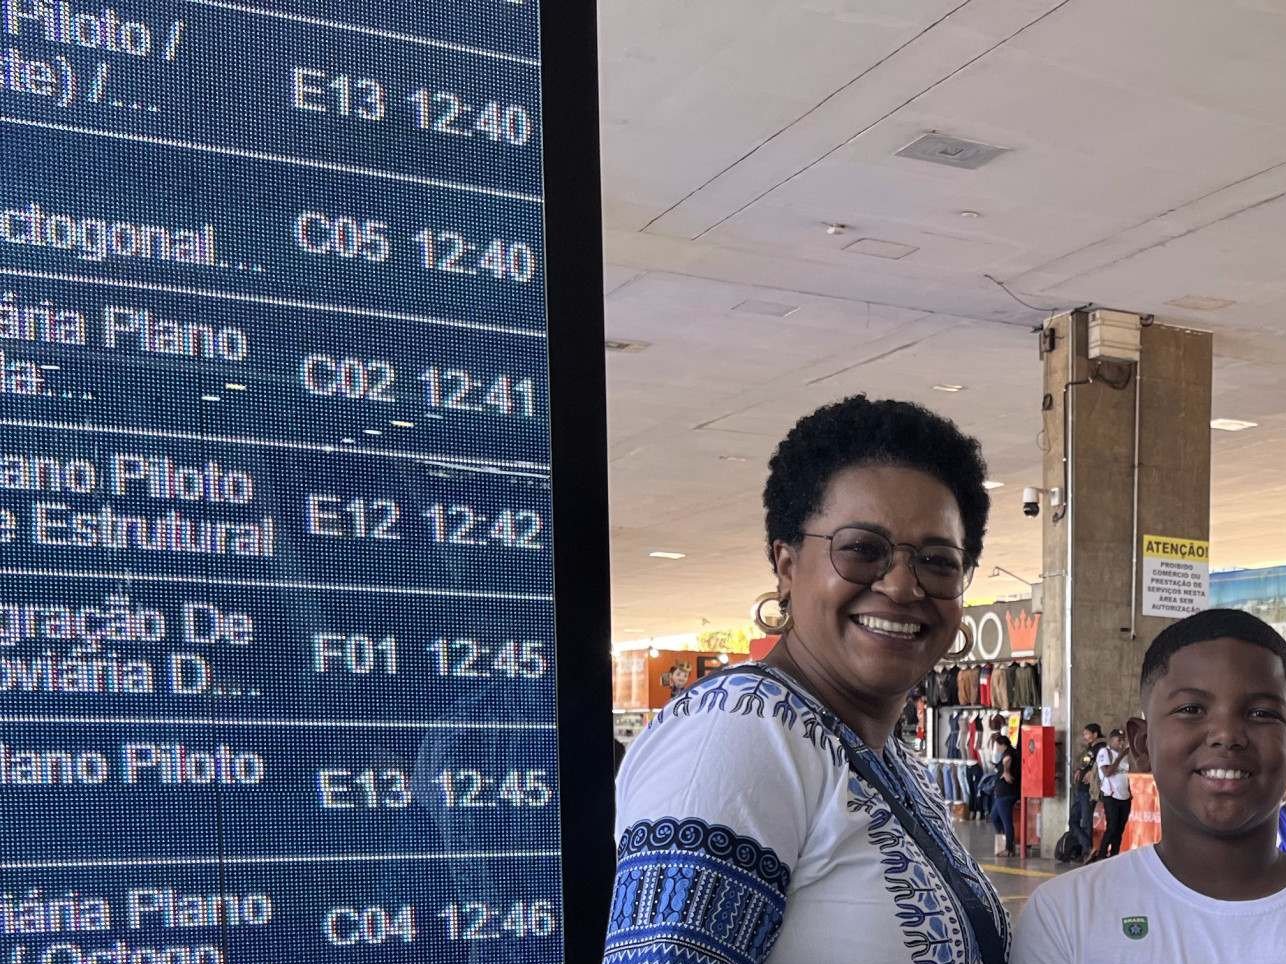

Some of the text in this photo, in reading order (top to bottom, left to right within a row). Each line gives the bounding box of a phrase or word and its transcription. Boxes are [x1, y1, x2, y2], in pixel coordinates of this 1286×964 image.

[291, 66, 533, 146] E13 12:40
[297, 211, 392, 263] C05
[414, 227, 536, 282] 12:40
[104, 305, 248, 361] Plano
[302, 354, 535, 416] C02 12:41
[111, 452, 253, 504] Piloto
[33, 500, 274, 557] Estrutural
[307, 495, 401, 539] E12
[424, 503, 545, 550] 12:42
[1146, 541, 1208, 559] ATENÇÃO!
[1161, 561, 1193, 570] PROIBIDO
[182, 601, 254, 645] De
[312, 634, 547, 679] F01 12:45
[122, 742, 265, 785] Piloto
[317, 768, 413, 809] E13
[435, 770, 553, 808] 12:45
[128, 887, 272, 929] Plano
[322, 905, 417, 945] C04
[440, 899, 557, 940] 12:46
